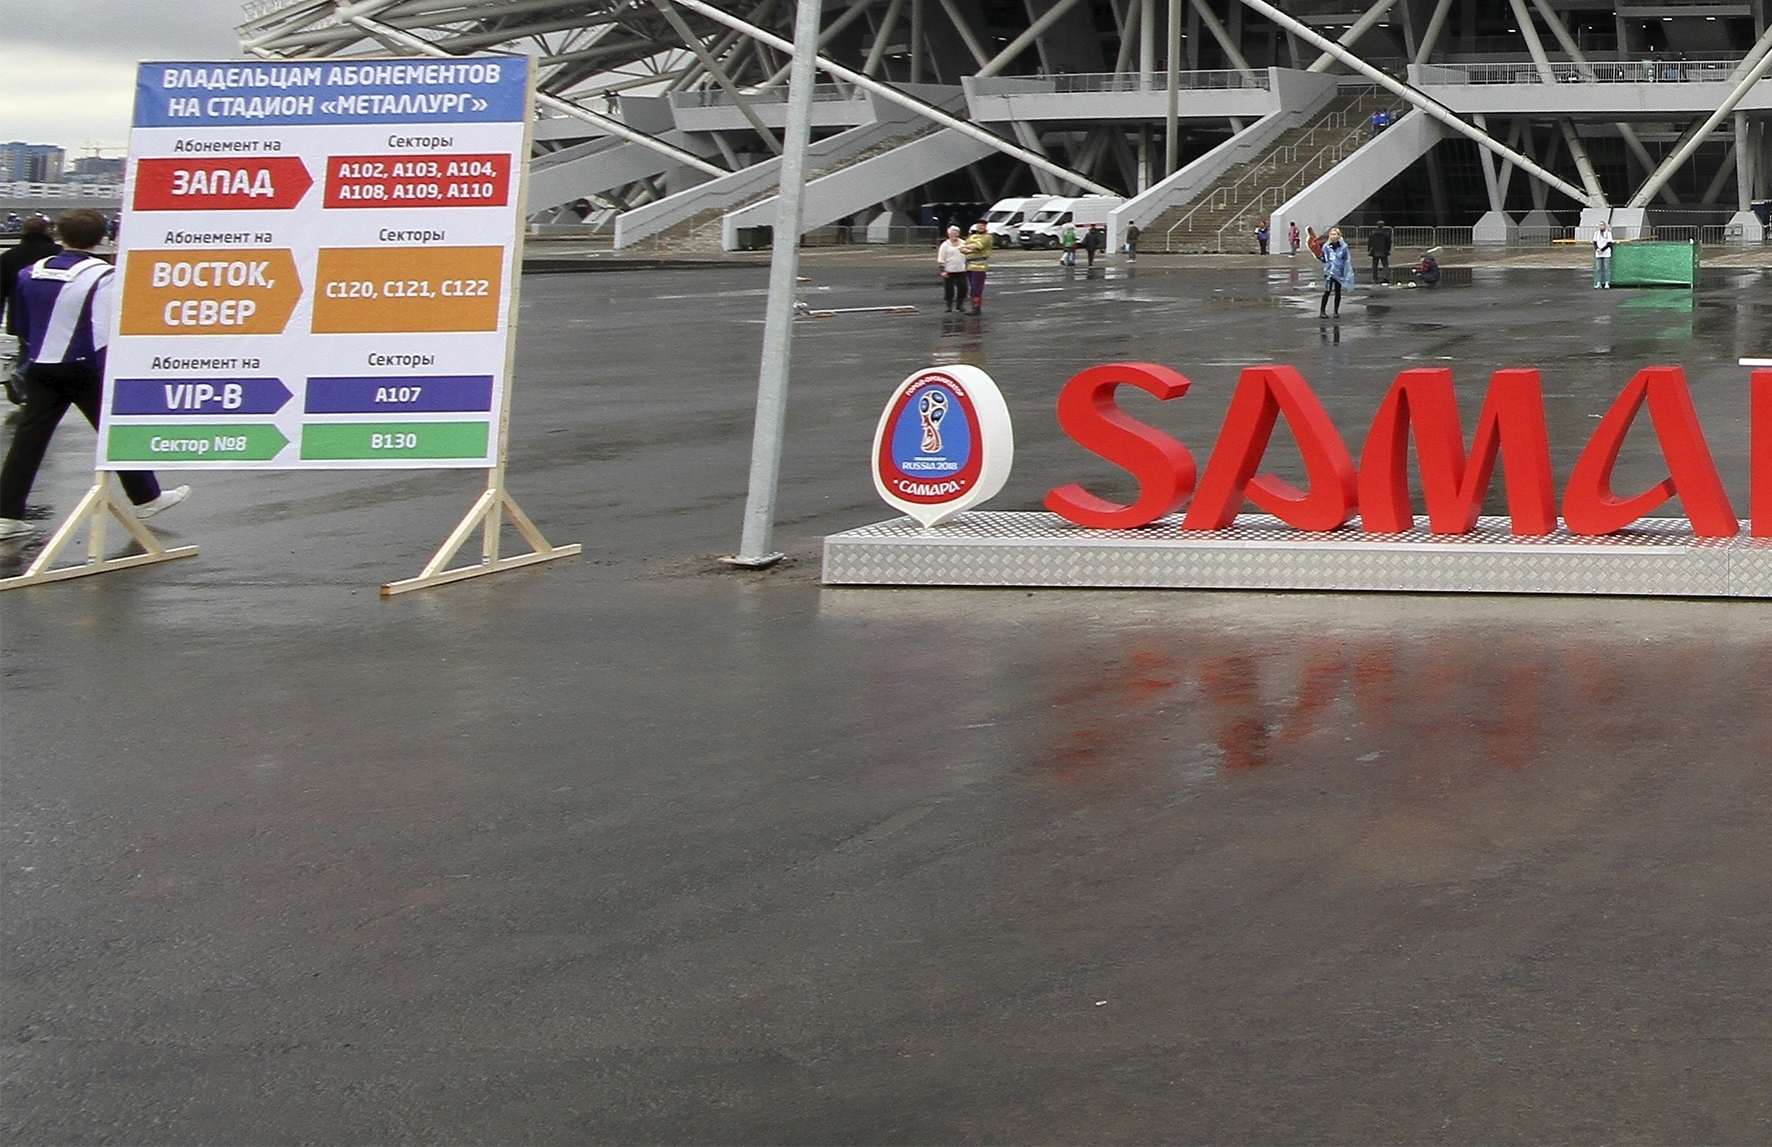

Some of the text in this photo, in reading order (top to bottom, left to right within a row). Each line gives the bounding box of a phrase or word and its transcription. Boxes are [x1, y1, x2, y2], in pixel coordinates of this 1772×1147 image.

[162, 64, 501, 90] ВЛАДЕЛЬЦАМ АБОНЕМЕНТОВ
[168, 93, 489, 119] НА СТАДИОН «МЕТАЛЛУРГ»
[174, 139, 281, 152] Абонемент на
[388, 135, 453, 150] Секторы
[338, 161, 497, 178] A102, A103, A104,
[171, 169, 275, 198] ЗАПАД
[338, 183, 493, 200] A108, A109, A110
[164, 231, 273, 244] Абонемент на
[379, 228, 446, 243] Секторы
[152, 261, 275, 289] ВОСТОК,
[325, 279, 489, 299] C120, C121, C122
[163, 300, 256, 326] СЕВЕР
[151, 356, 260, 369] Абонемент на
[367, 353, 435, 368] Секторы
[164, 383, 243, 410] VIP-B
[374, 387, 422, 403] A107
[150, 436, 248, 455] Сектор №8
[370, 433, 417, 449] B130
[902, 461, 936, 470] RUSSIA
[899, 480, 961, 496] САМАРА
